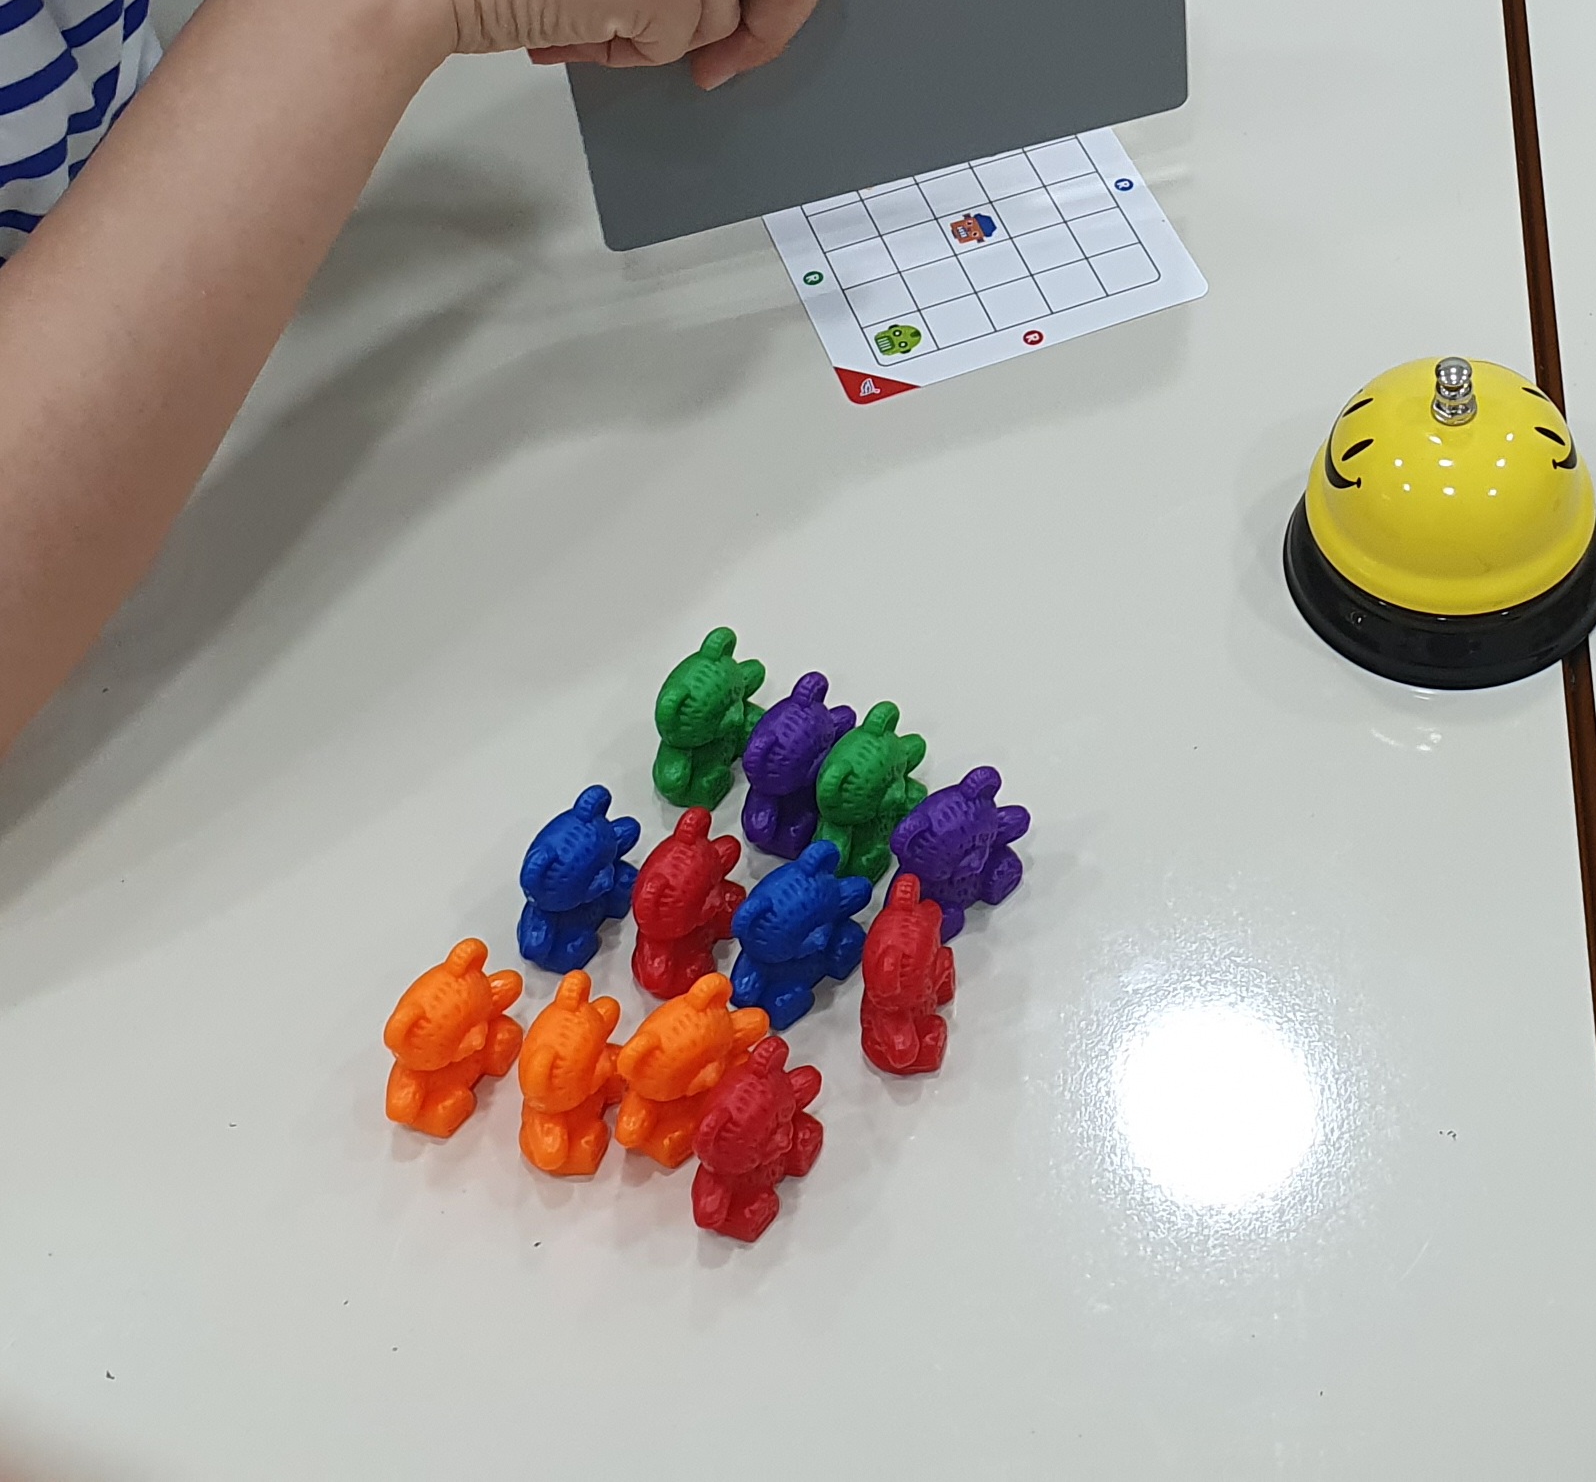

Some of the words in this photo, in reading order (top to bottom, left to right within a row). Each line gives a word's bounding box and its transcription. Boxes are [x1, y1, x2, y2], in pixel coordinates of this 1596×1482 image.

[1116, 179, 1131, 190] R
[805, 273, 821, 284] R
[1025, 332, 1041, 344] R
